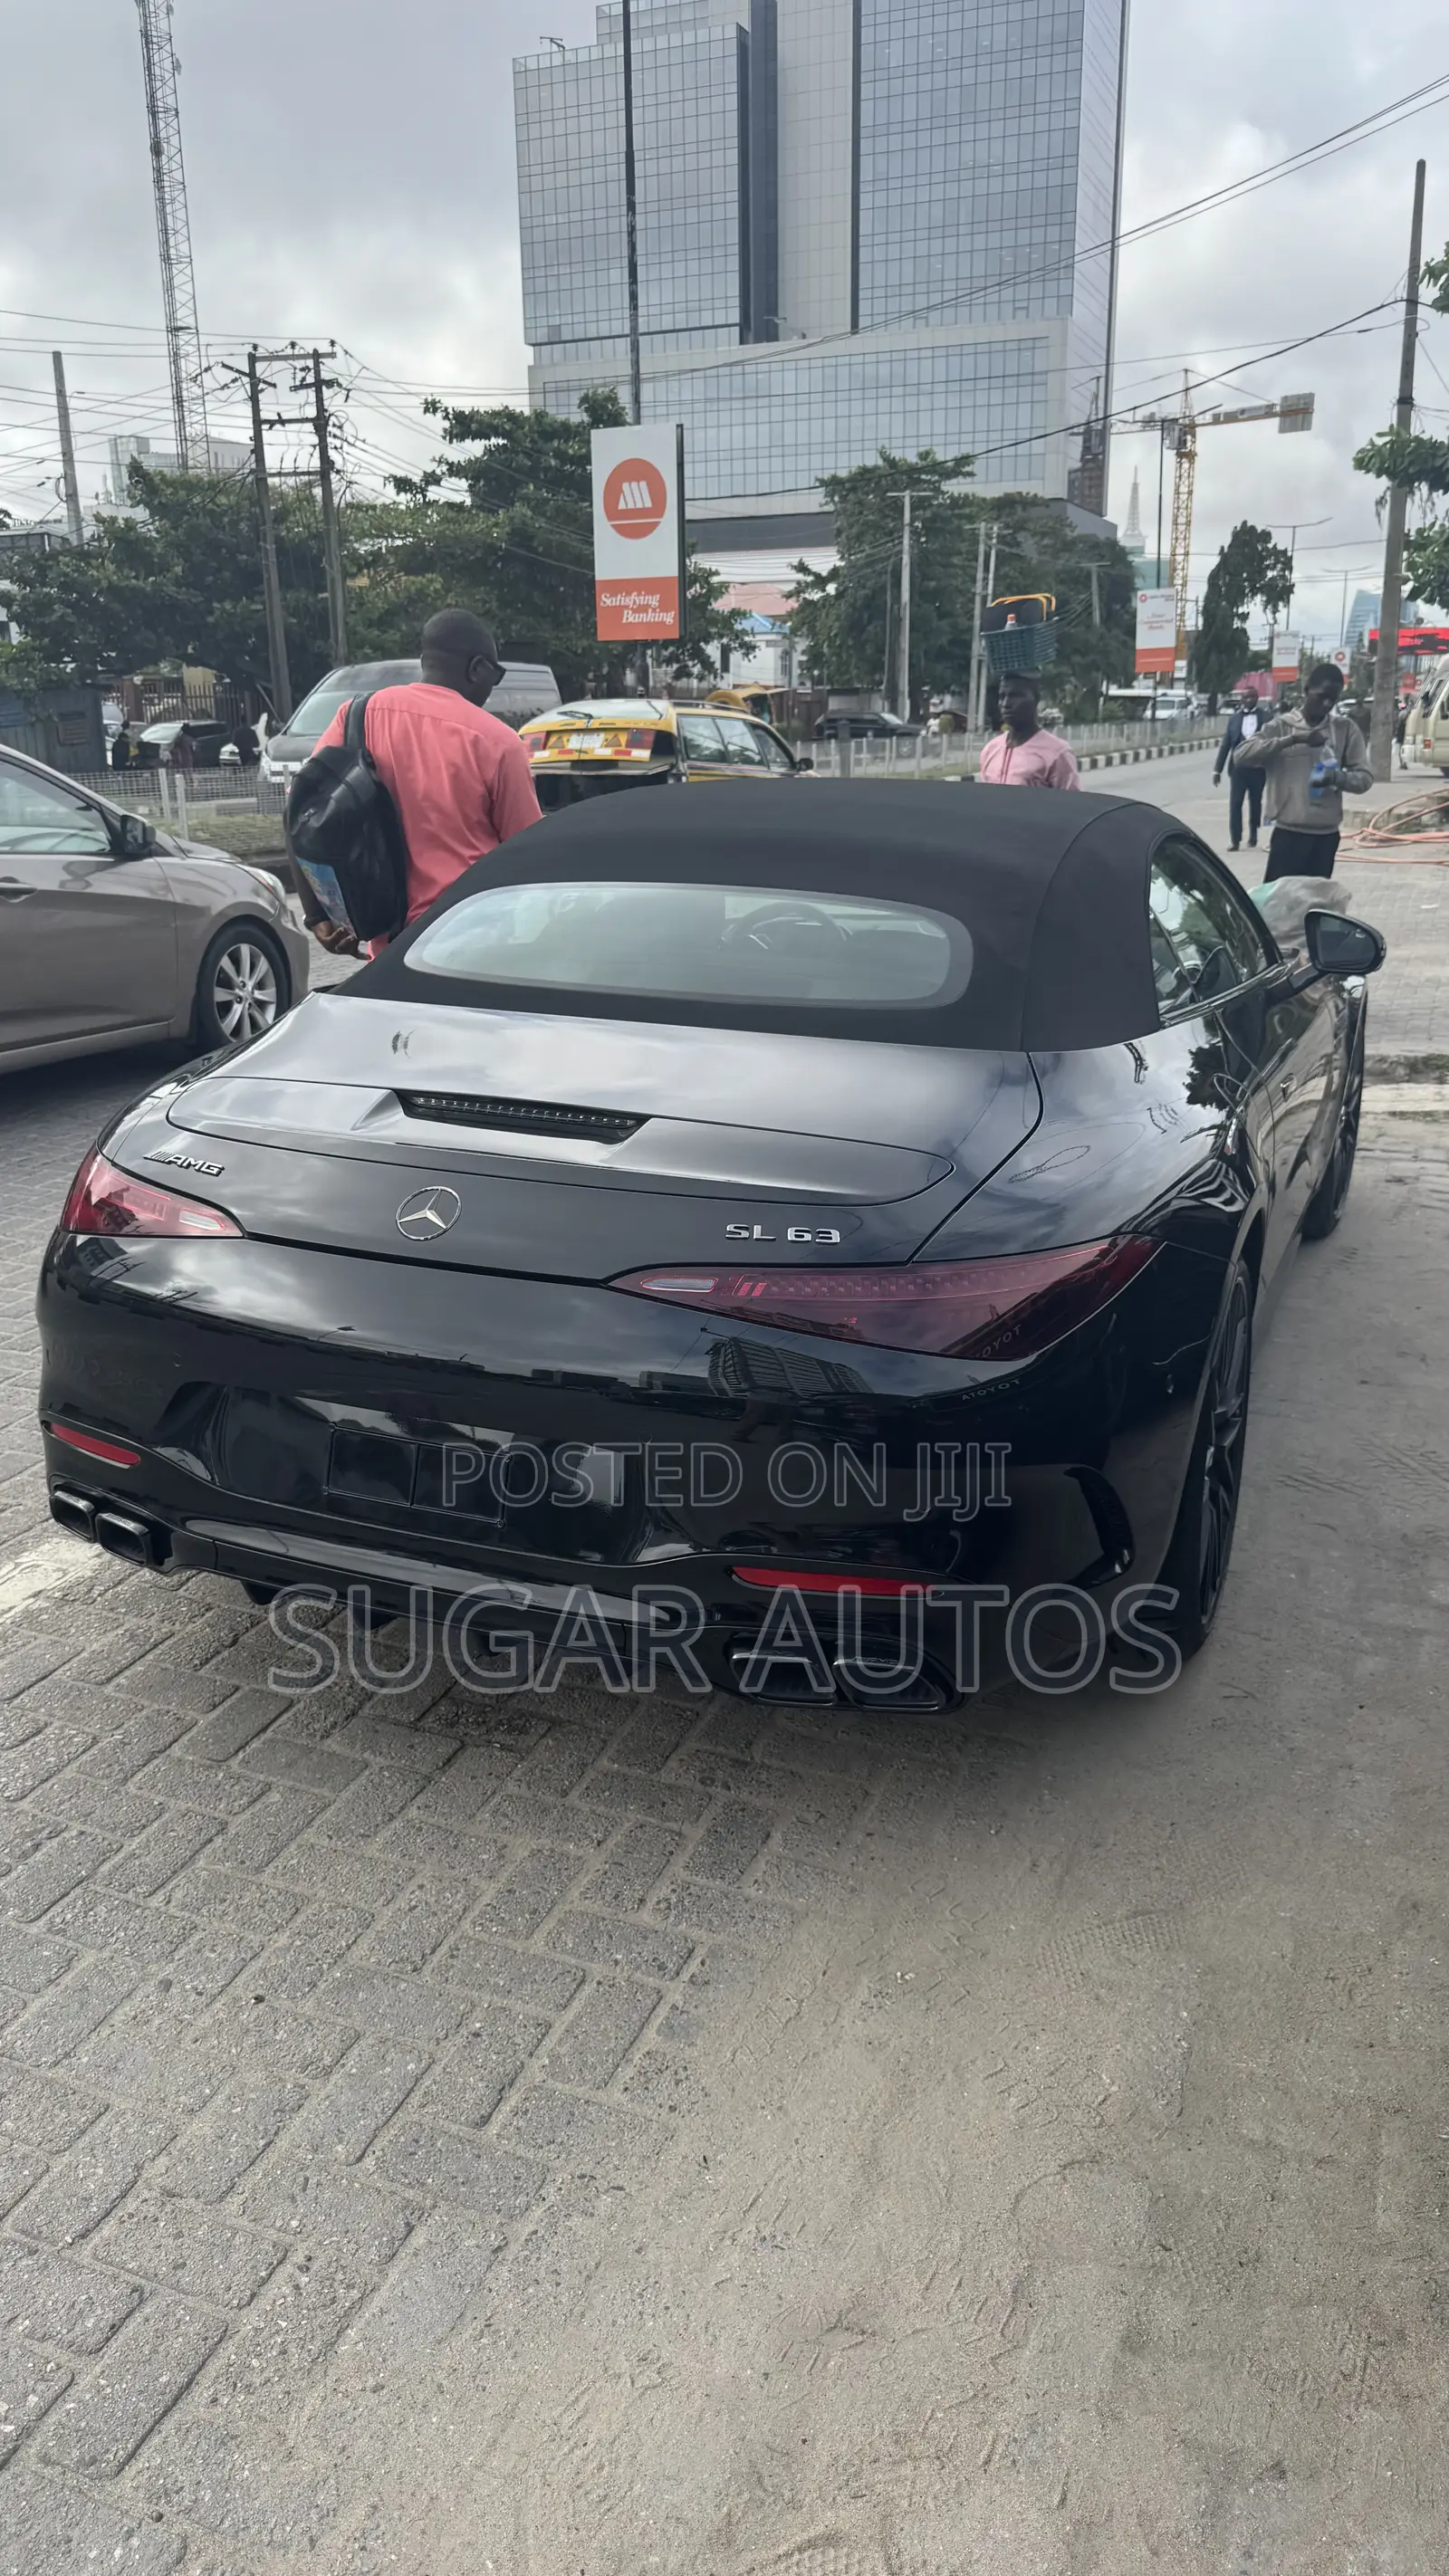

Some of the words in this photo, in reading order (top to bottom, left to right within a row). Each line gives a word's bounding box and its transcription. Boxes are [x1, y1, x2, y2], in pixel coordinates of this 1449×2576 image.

[600, 590, 660, 608] Satisfying
[621, 608, 675, 626] Banking
[161, 1153, 226, 1177] AMG
[725, 1223, 777, 1241] SL
[786, 1227, 840, 1245] 63
